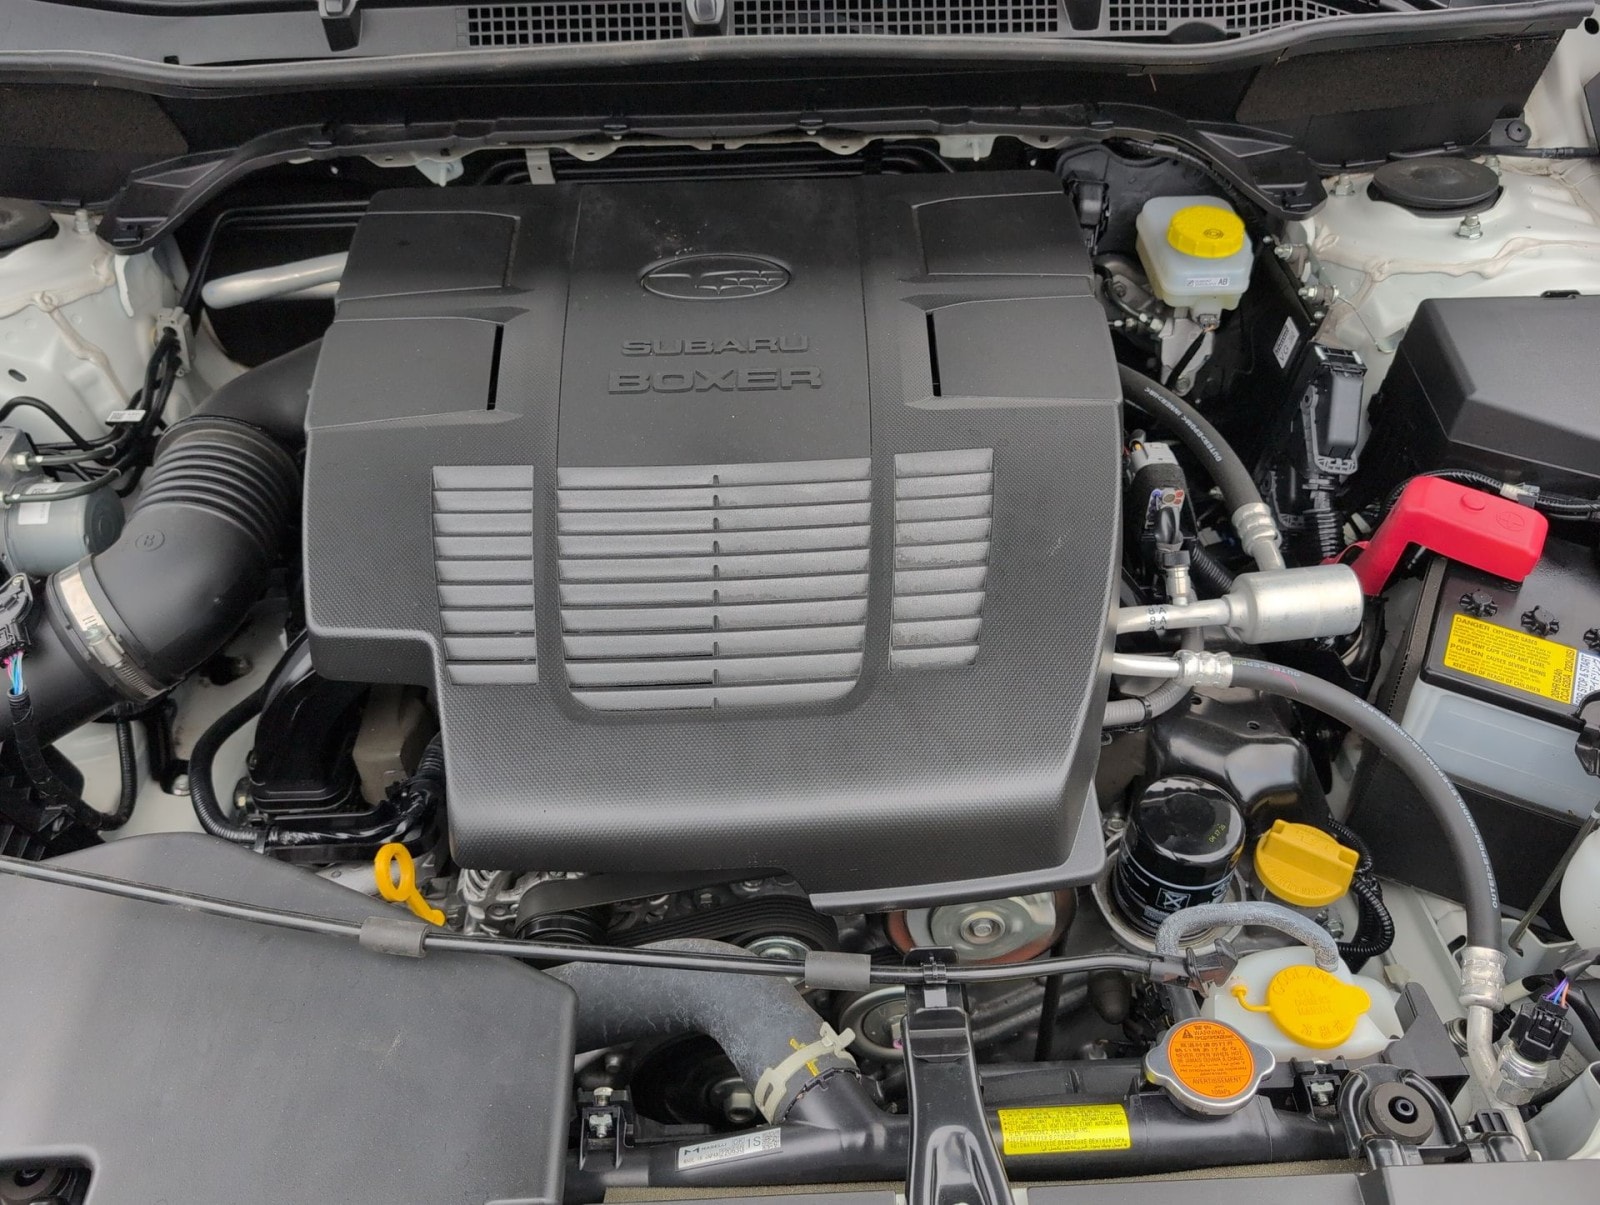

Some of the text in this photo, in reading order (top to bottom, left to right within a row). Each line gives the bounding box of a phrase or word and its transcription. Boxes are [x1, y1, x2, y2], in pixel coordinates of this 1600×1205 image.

[621, 335, 809, 357] SUBARU
[608, 366, 823, 395] BOXER
[1455, 617, 1490, 632] DANGER
[1450, 643, 1484, 658] POISON
[1486, 654, 1506, 665] CAUSES
[1508, 661, 1527, 671] SEVERE
[1458, 638, 1546, 669] KEEP VENT CAPS TIGHT AND LEVEL
[1580, 653, 1591, 673] START
[1453, 662, 1466, 671] KEEP
[1467, 666, 1478, 675] OUT
[1487, 672, 1505, 682] REACH
[1513, 680, 1541, 694] CHILDREN
[1577, 677, 1588, 694] STOP
[1272, 967, 1340, 995] COOLANT
[1192, 1076, 1242, 1085] AVERTISSEMENT
